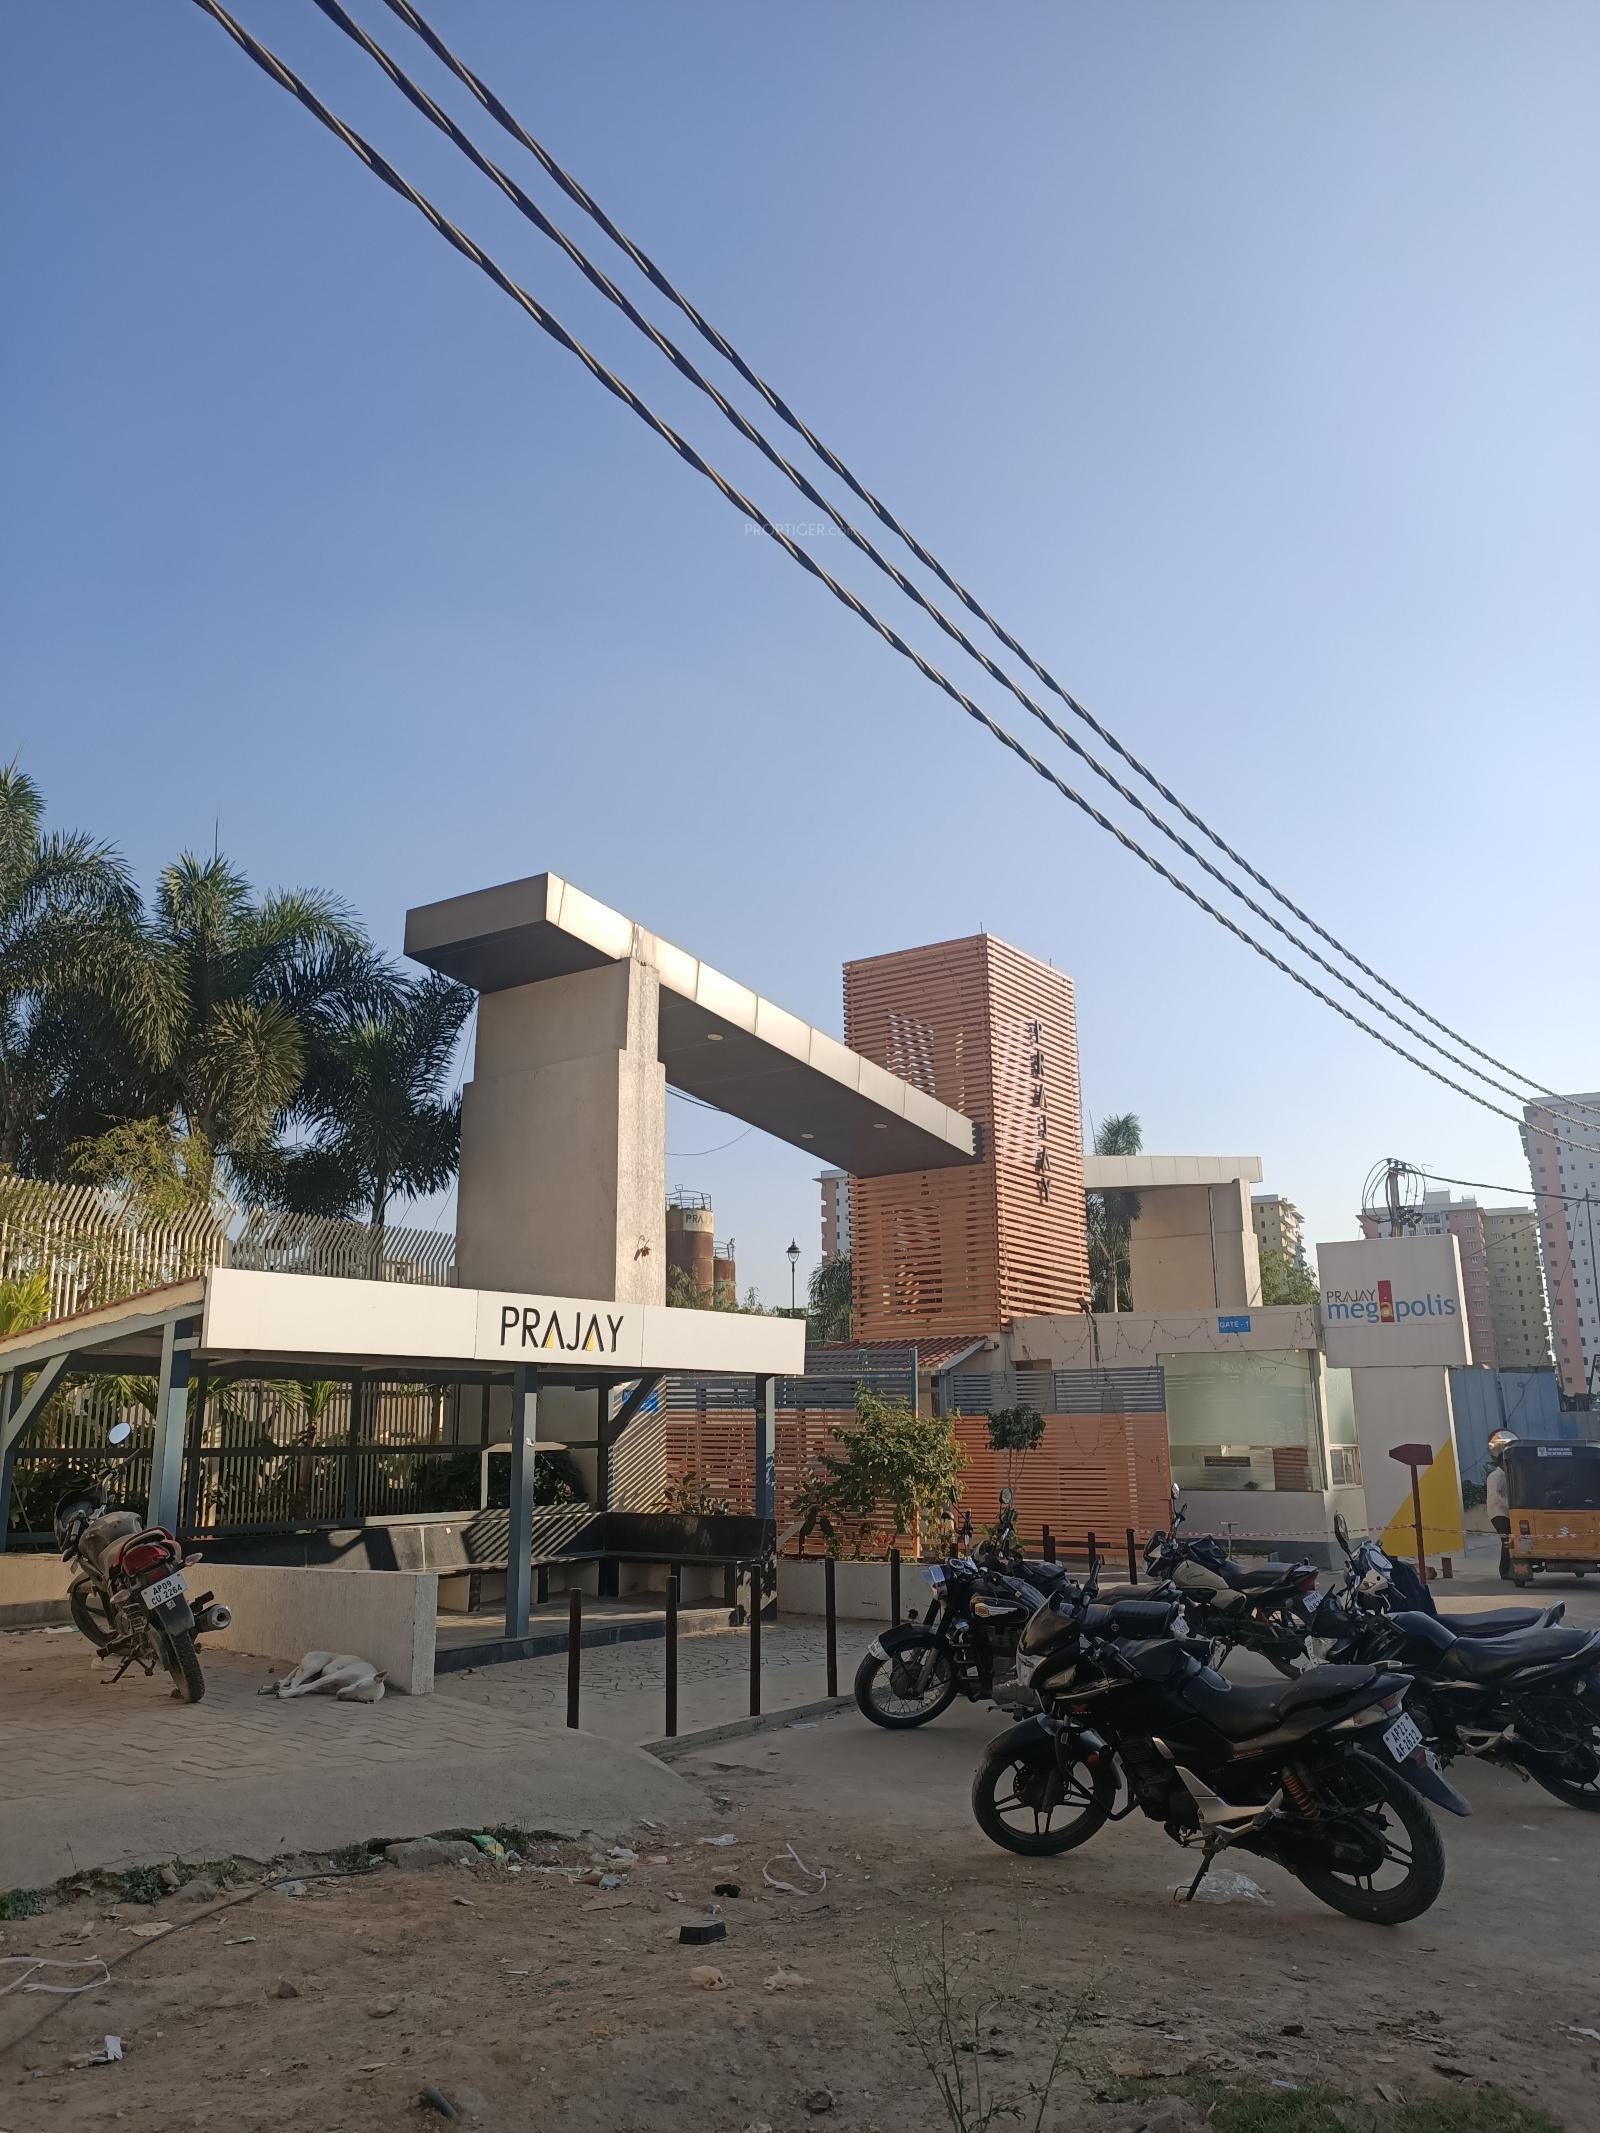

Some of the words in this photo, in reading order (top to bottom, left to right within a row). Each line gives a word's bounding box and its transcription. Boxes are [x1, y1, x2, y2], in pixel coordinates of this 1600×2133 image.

[1031, 1018, 1051, 1203] PRAJAY
[1326, 1289, 1376, 1303] PRAJAY
[1328, 1294, 1456, 1324] megapolis
[500, 1306, 624, 1353] PRAJAY
[1219, 1320, 1239, 1328] GATE
[152, 1580, 172, 1596] AP09
[163, 1583, 183, 1599] 2264
[1391, 1721, 1408, 1743] AP22
